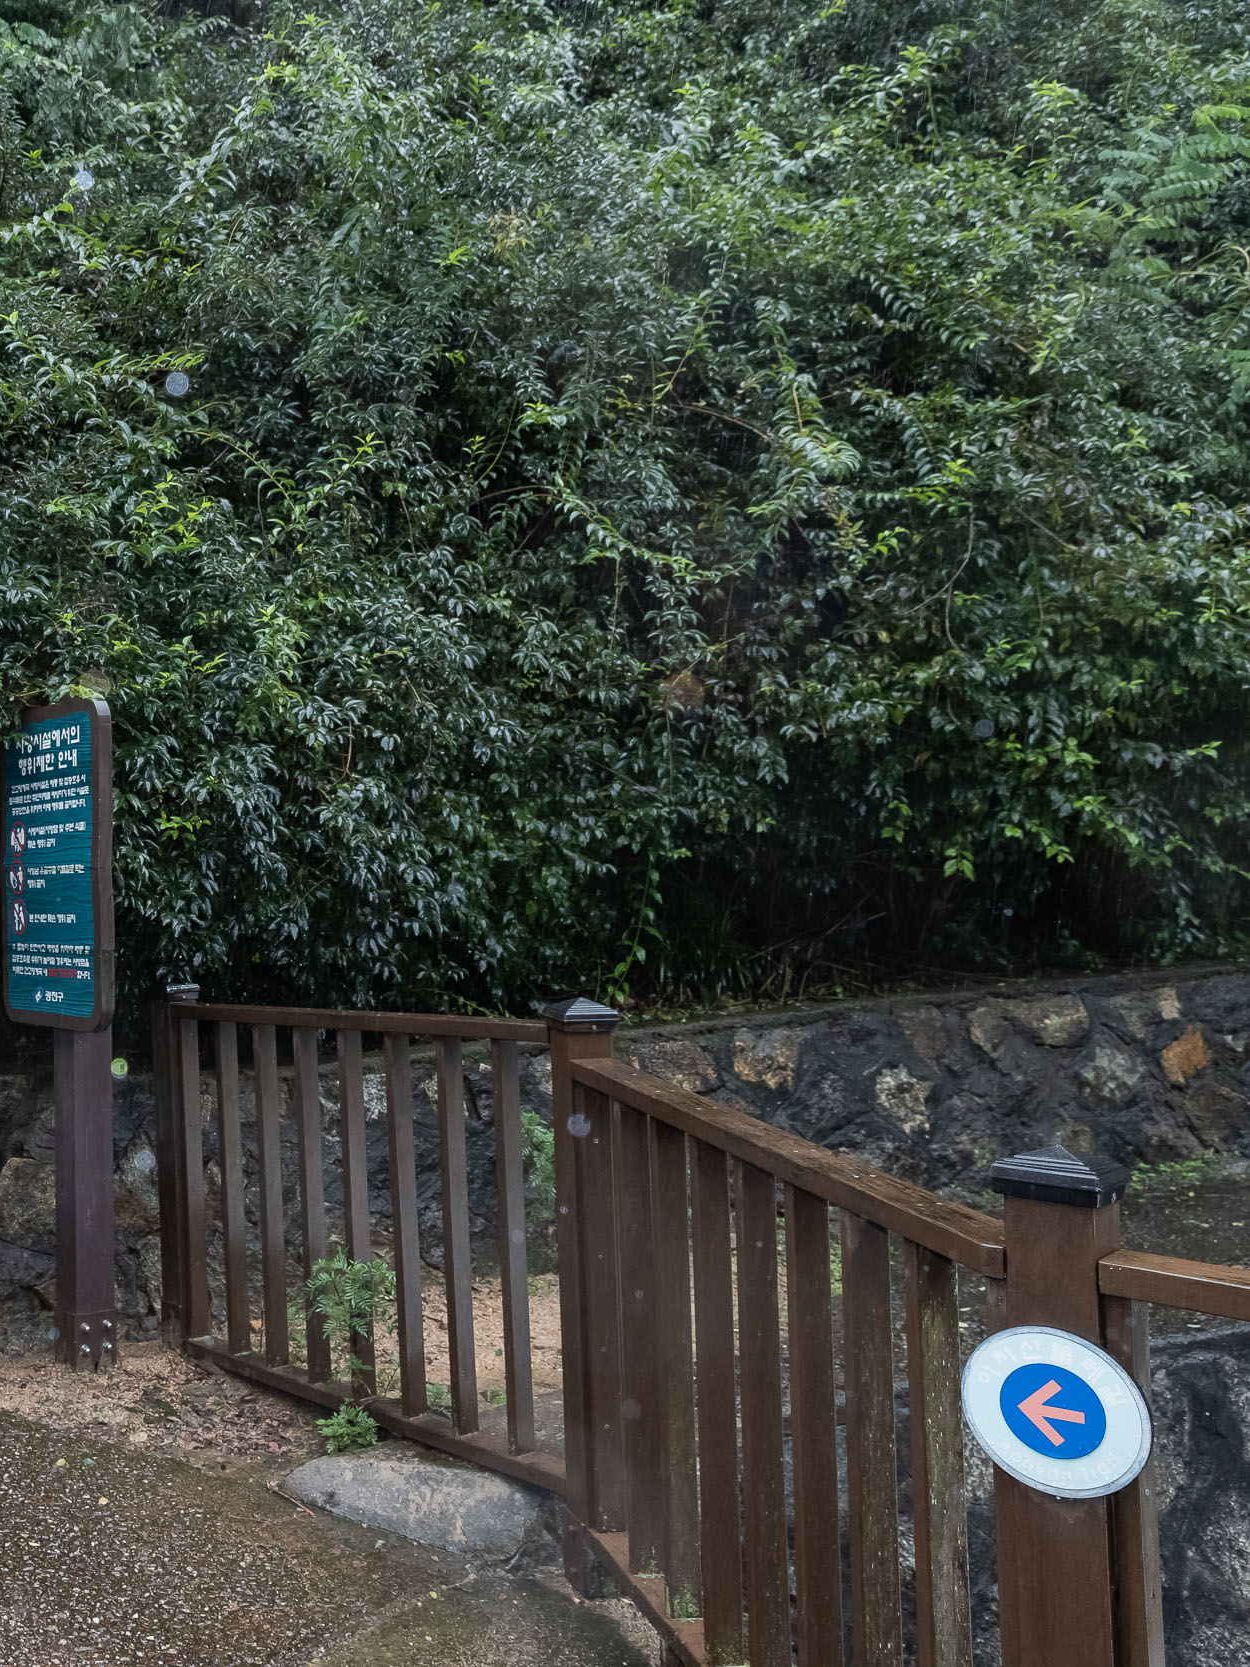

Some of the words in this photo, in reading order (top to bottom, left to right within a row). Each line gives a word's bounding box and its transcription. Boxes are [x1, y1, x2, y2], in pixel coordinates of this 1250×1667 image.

[19, 753, 54, 776] 행위제한
[58, 749, 78, 769] 안내
[60, 824, 65, 833] 및
[38, 839, 46, 848] 행위
[47, 839, 57, 848] 금지
[37, 879, 45, 888] 금지
[57, 914, 65, 923] 행위
[66, 914, 75, 923] 금지
[45, 991, 64, 1002] 광진구
